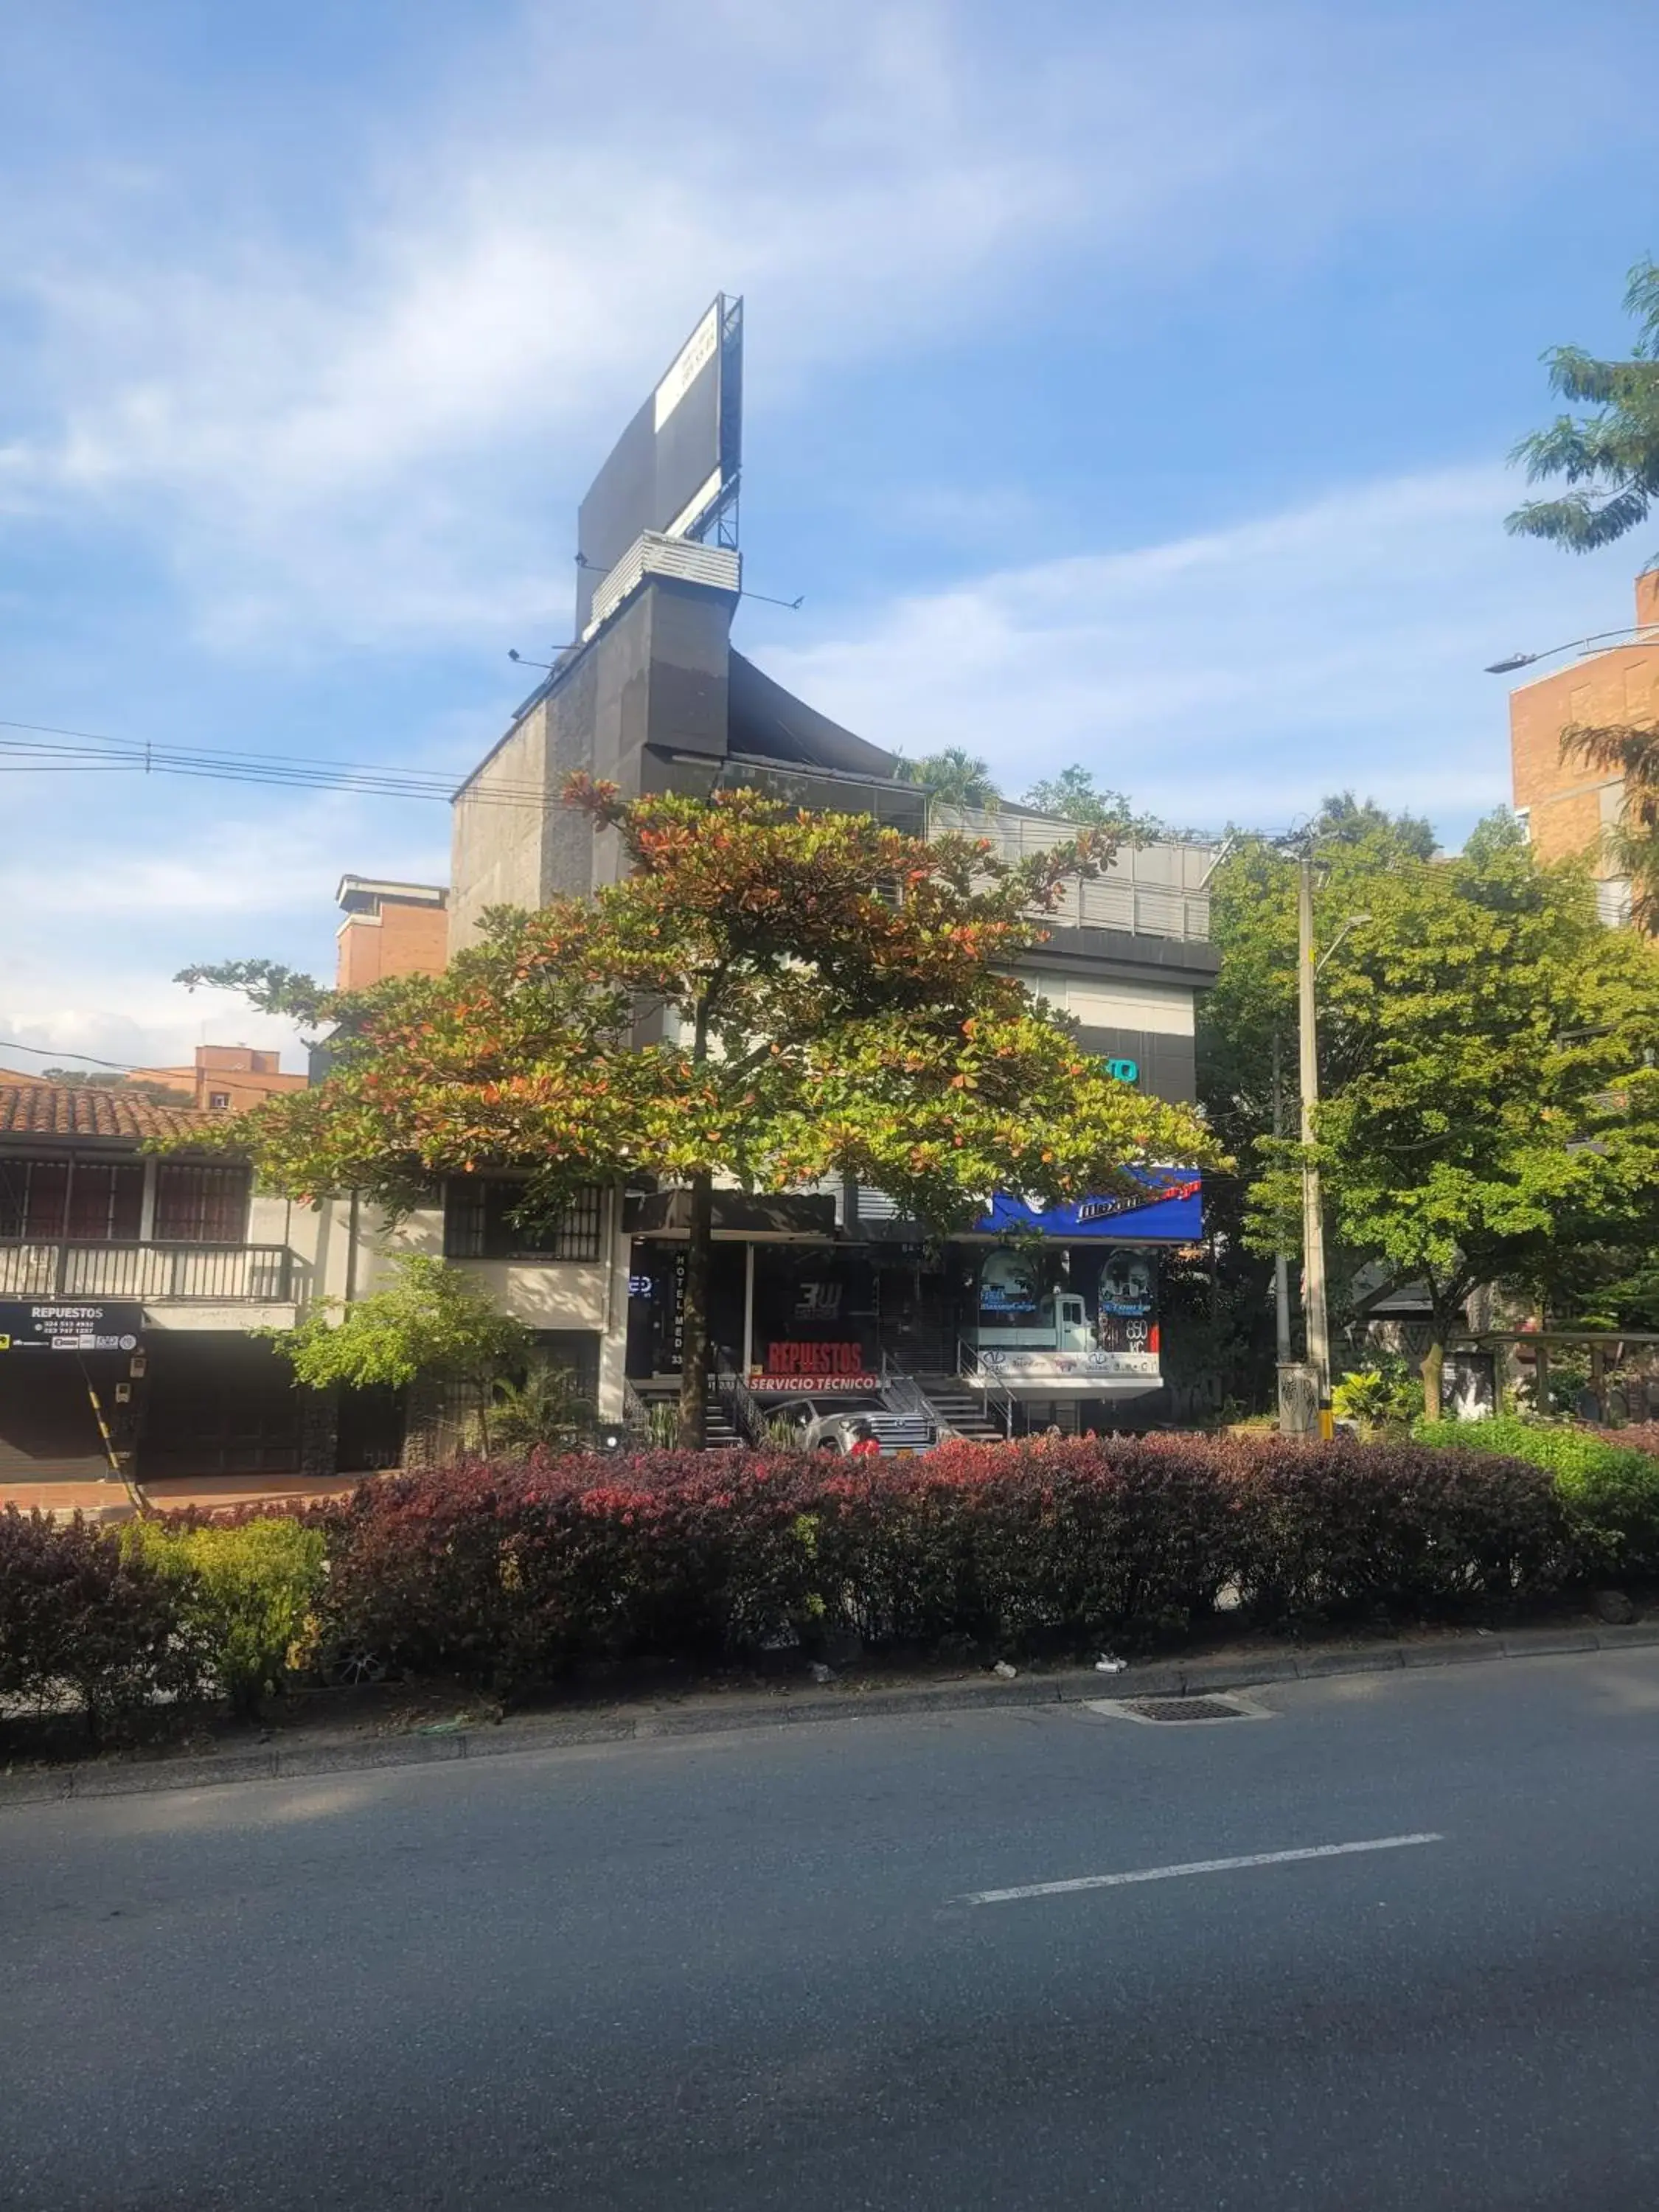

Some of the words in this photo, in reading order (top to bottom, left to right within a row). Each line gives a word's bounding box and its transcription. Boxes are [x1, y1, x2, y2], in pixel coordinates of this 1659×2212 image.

[676, 1256, 685, 1310] HOTEL
[32, 1307, 103, 1318] REPUESTOS
[768, 1342, 863, 1373] REPUESTOS
[751, 1376, 813, 1391] SERVICIO
